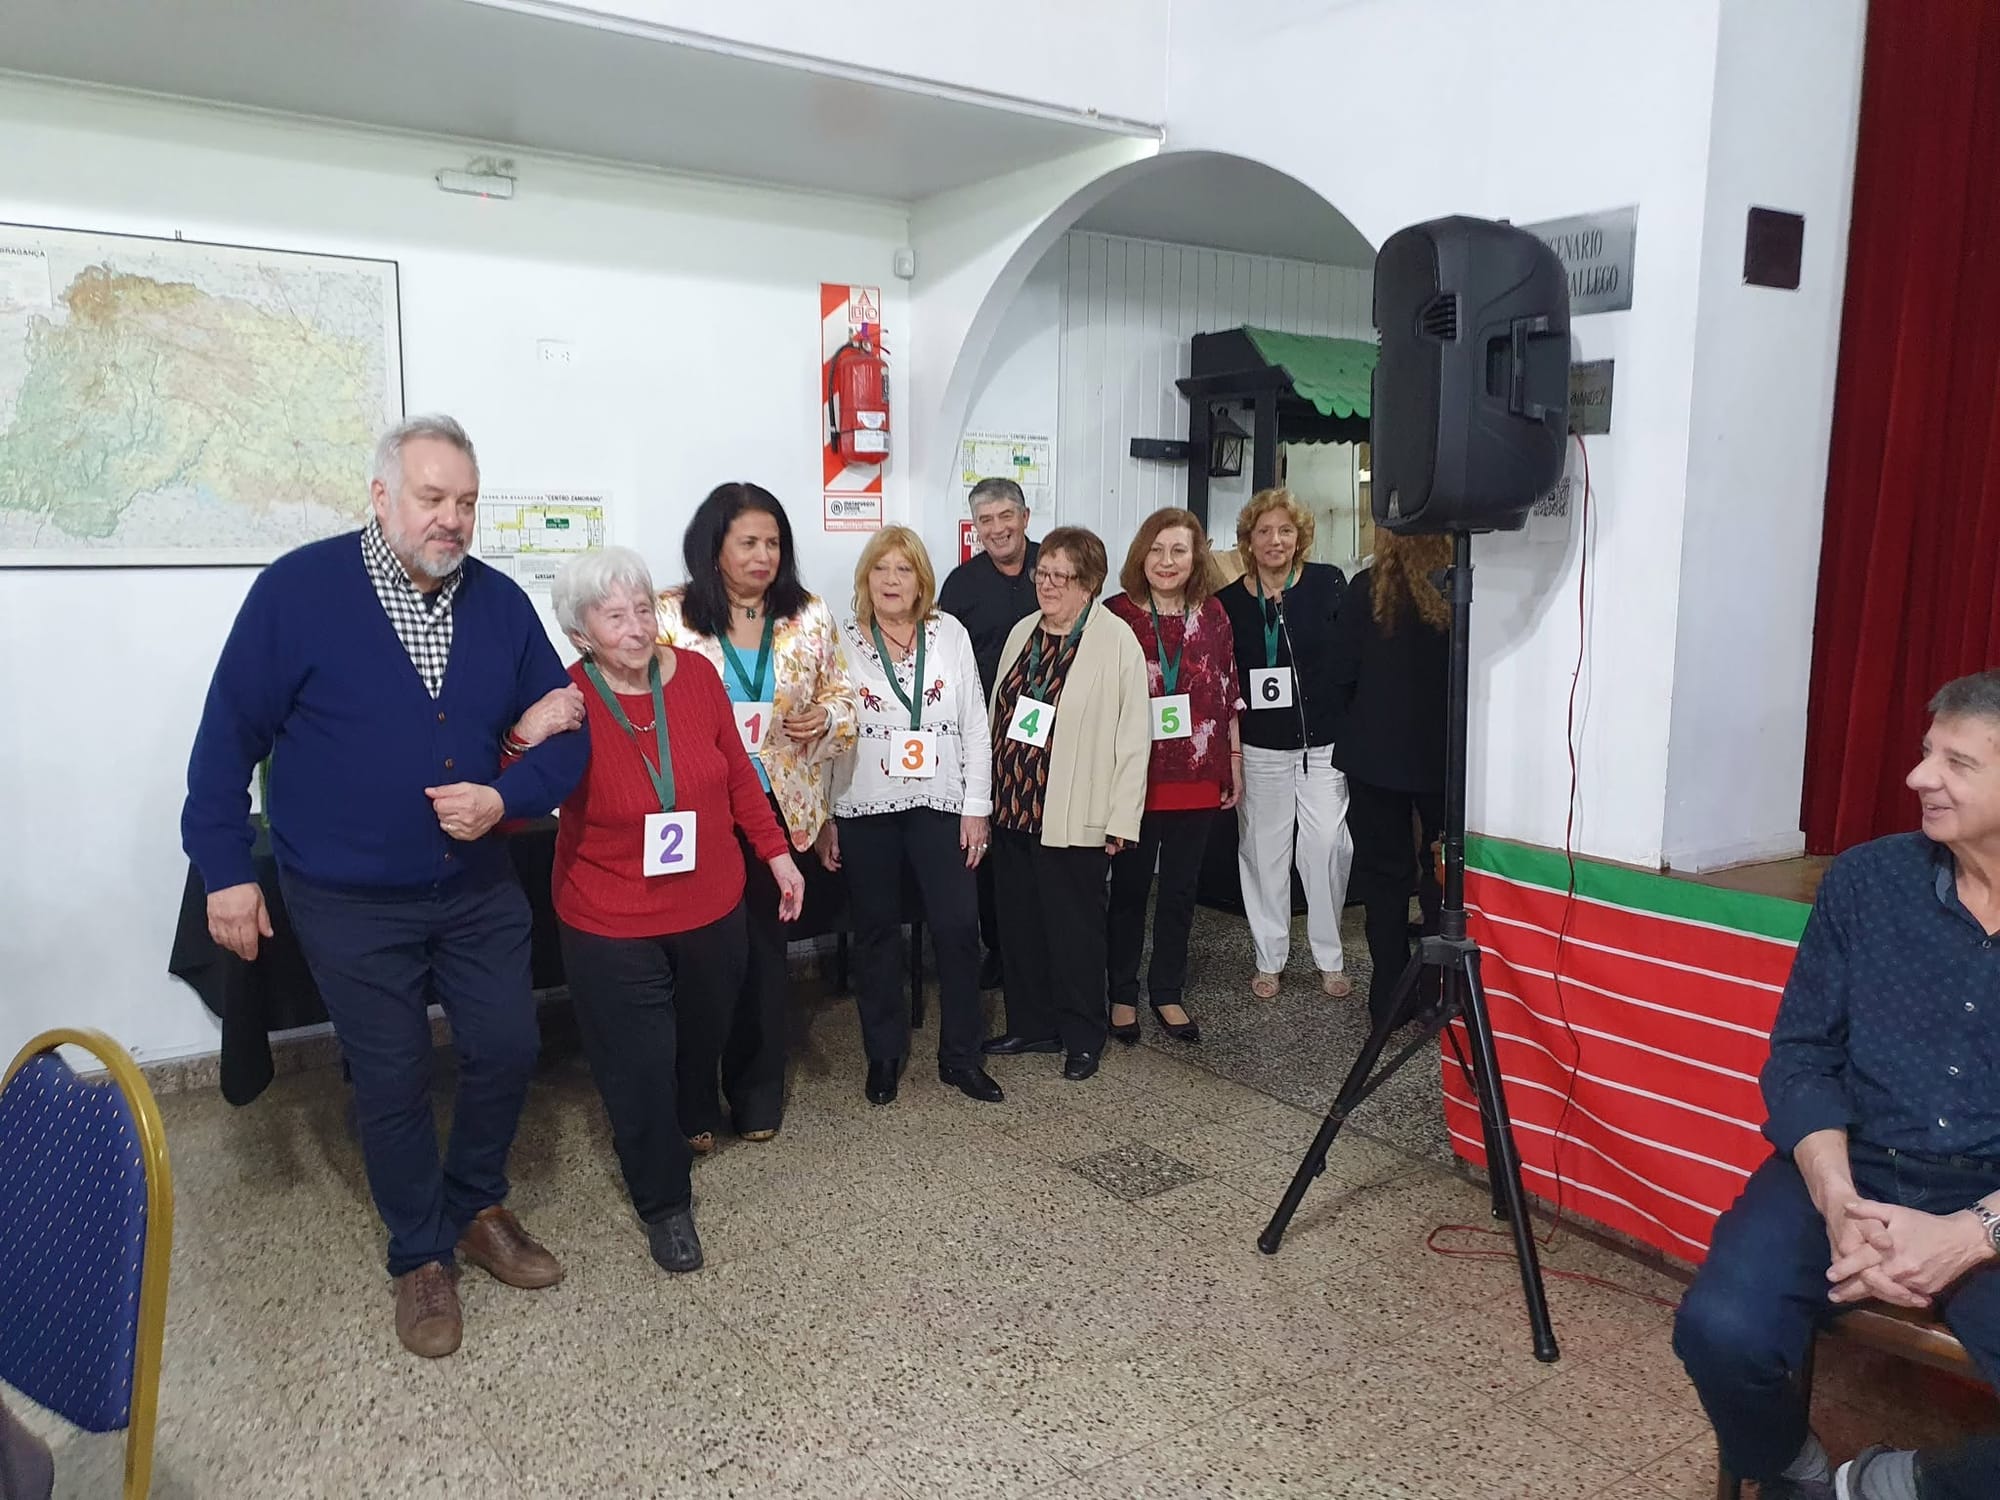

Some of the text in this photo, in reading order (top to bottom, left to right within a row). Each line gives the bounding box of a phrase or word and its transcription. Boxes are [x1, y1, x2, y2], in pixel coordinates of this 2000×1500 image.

[1567, 264, 1618, 297] ALLEGO
[1262, 677, 1280, 702] 6
[745, 713, 761, 744] 1
[1018, 708, 1039, 738] 4
[1161, 706, 1180, 734] 5
[902, 739, 924, 770] 3
[660, 823, 684, 864] 2
